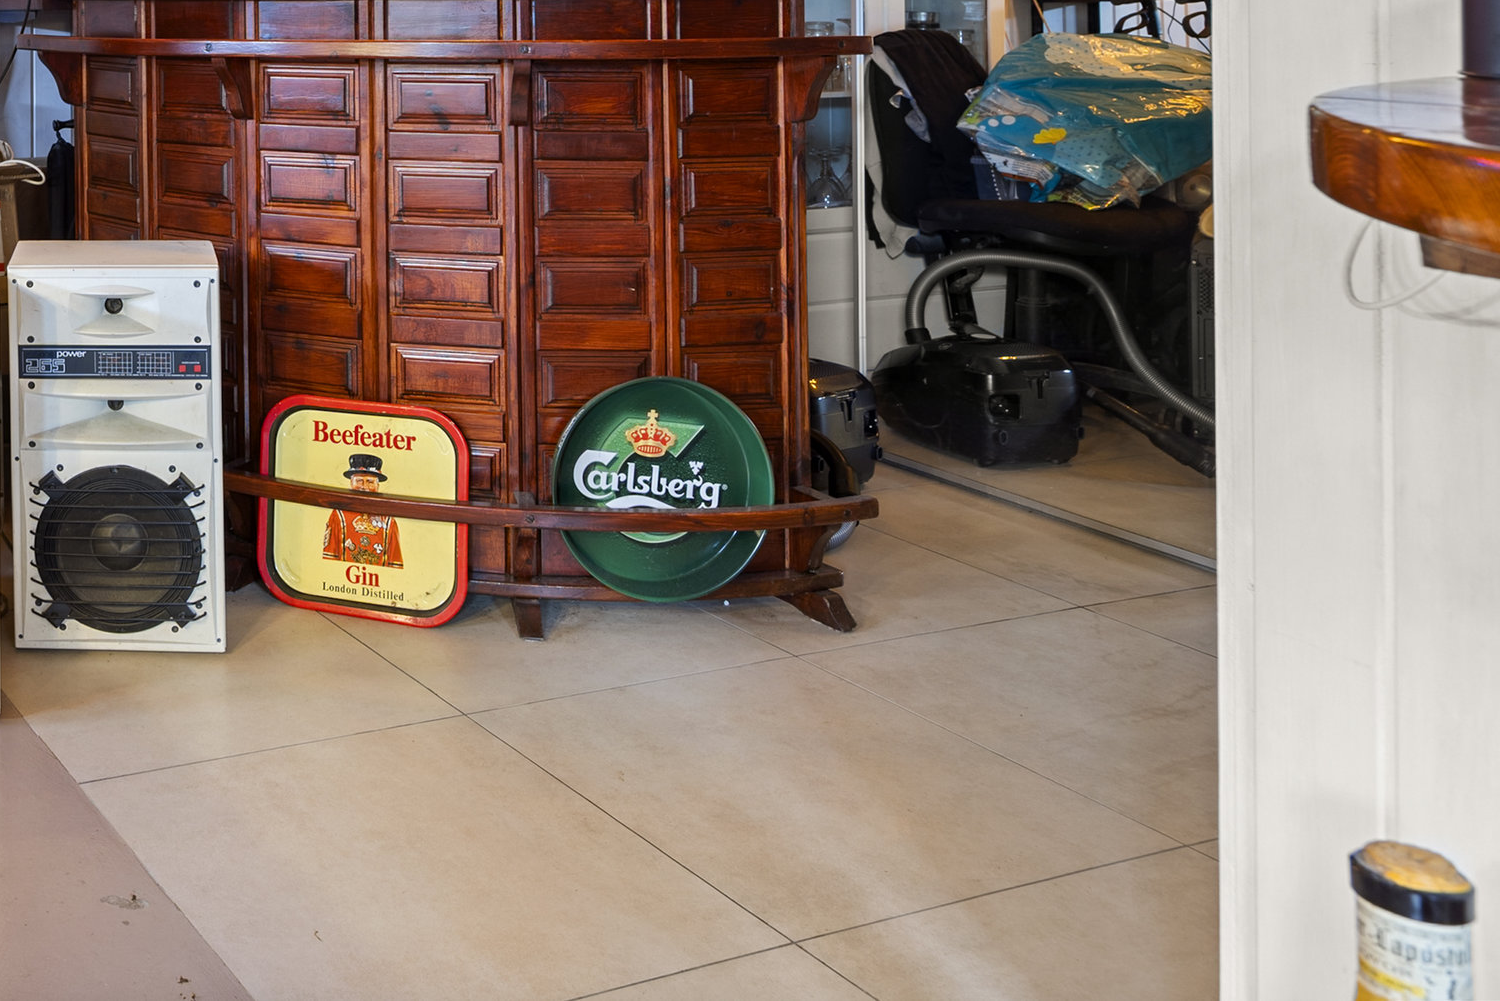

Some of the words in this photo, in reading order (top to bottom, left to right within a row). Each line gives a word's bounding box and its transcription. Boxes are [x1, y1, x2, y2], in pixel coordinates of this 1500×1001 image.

[56, 350, 87, 359] power
[26, 358, 66, 373] 265
[312, 420, 417, 451] Beefeater
[573, 449, 721, 509] Carlsberg
[345, 564, 380, 587] Gin
[322, 581, 357, 595] London
[361, 586, 404, 601] Distilled
